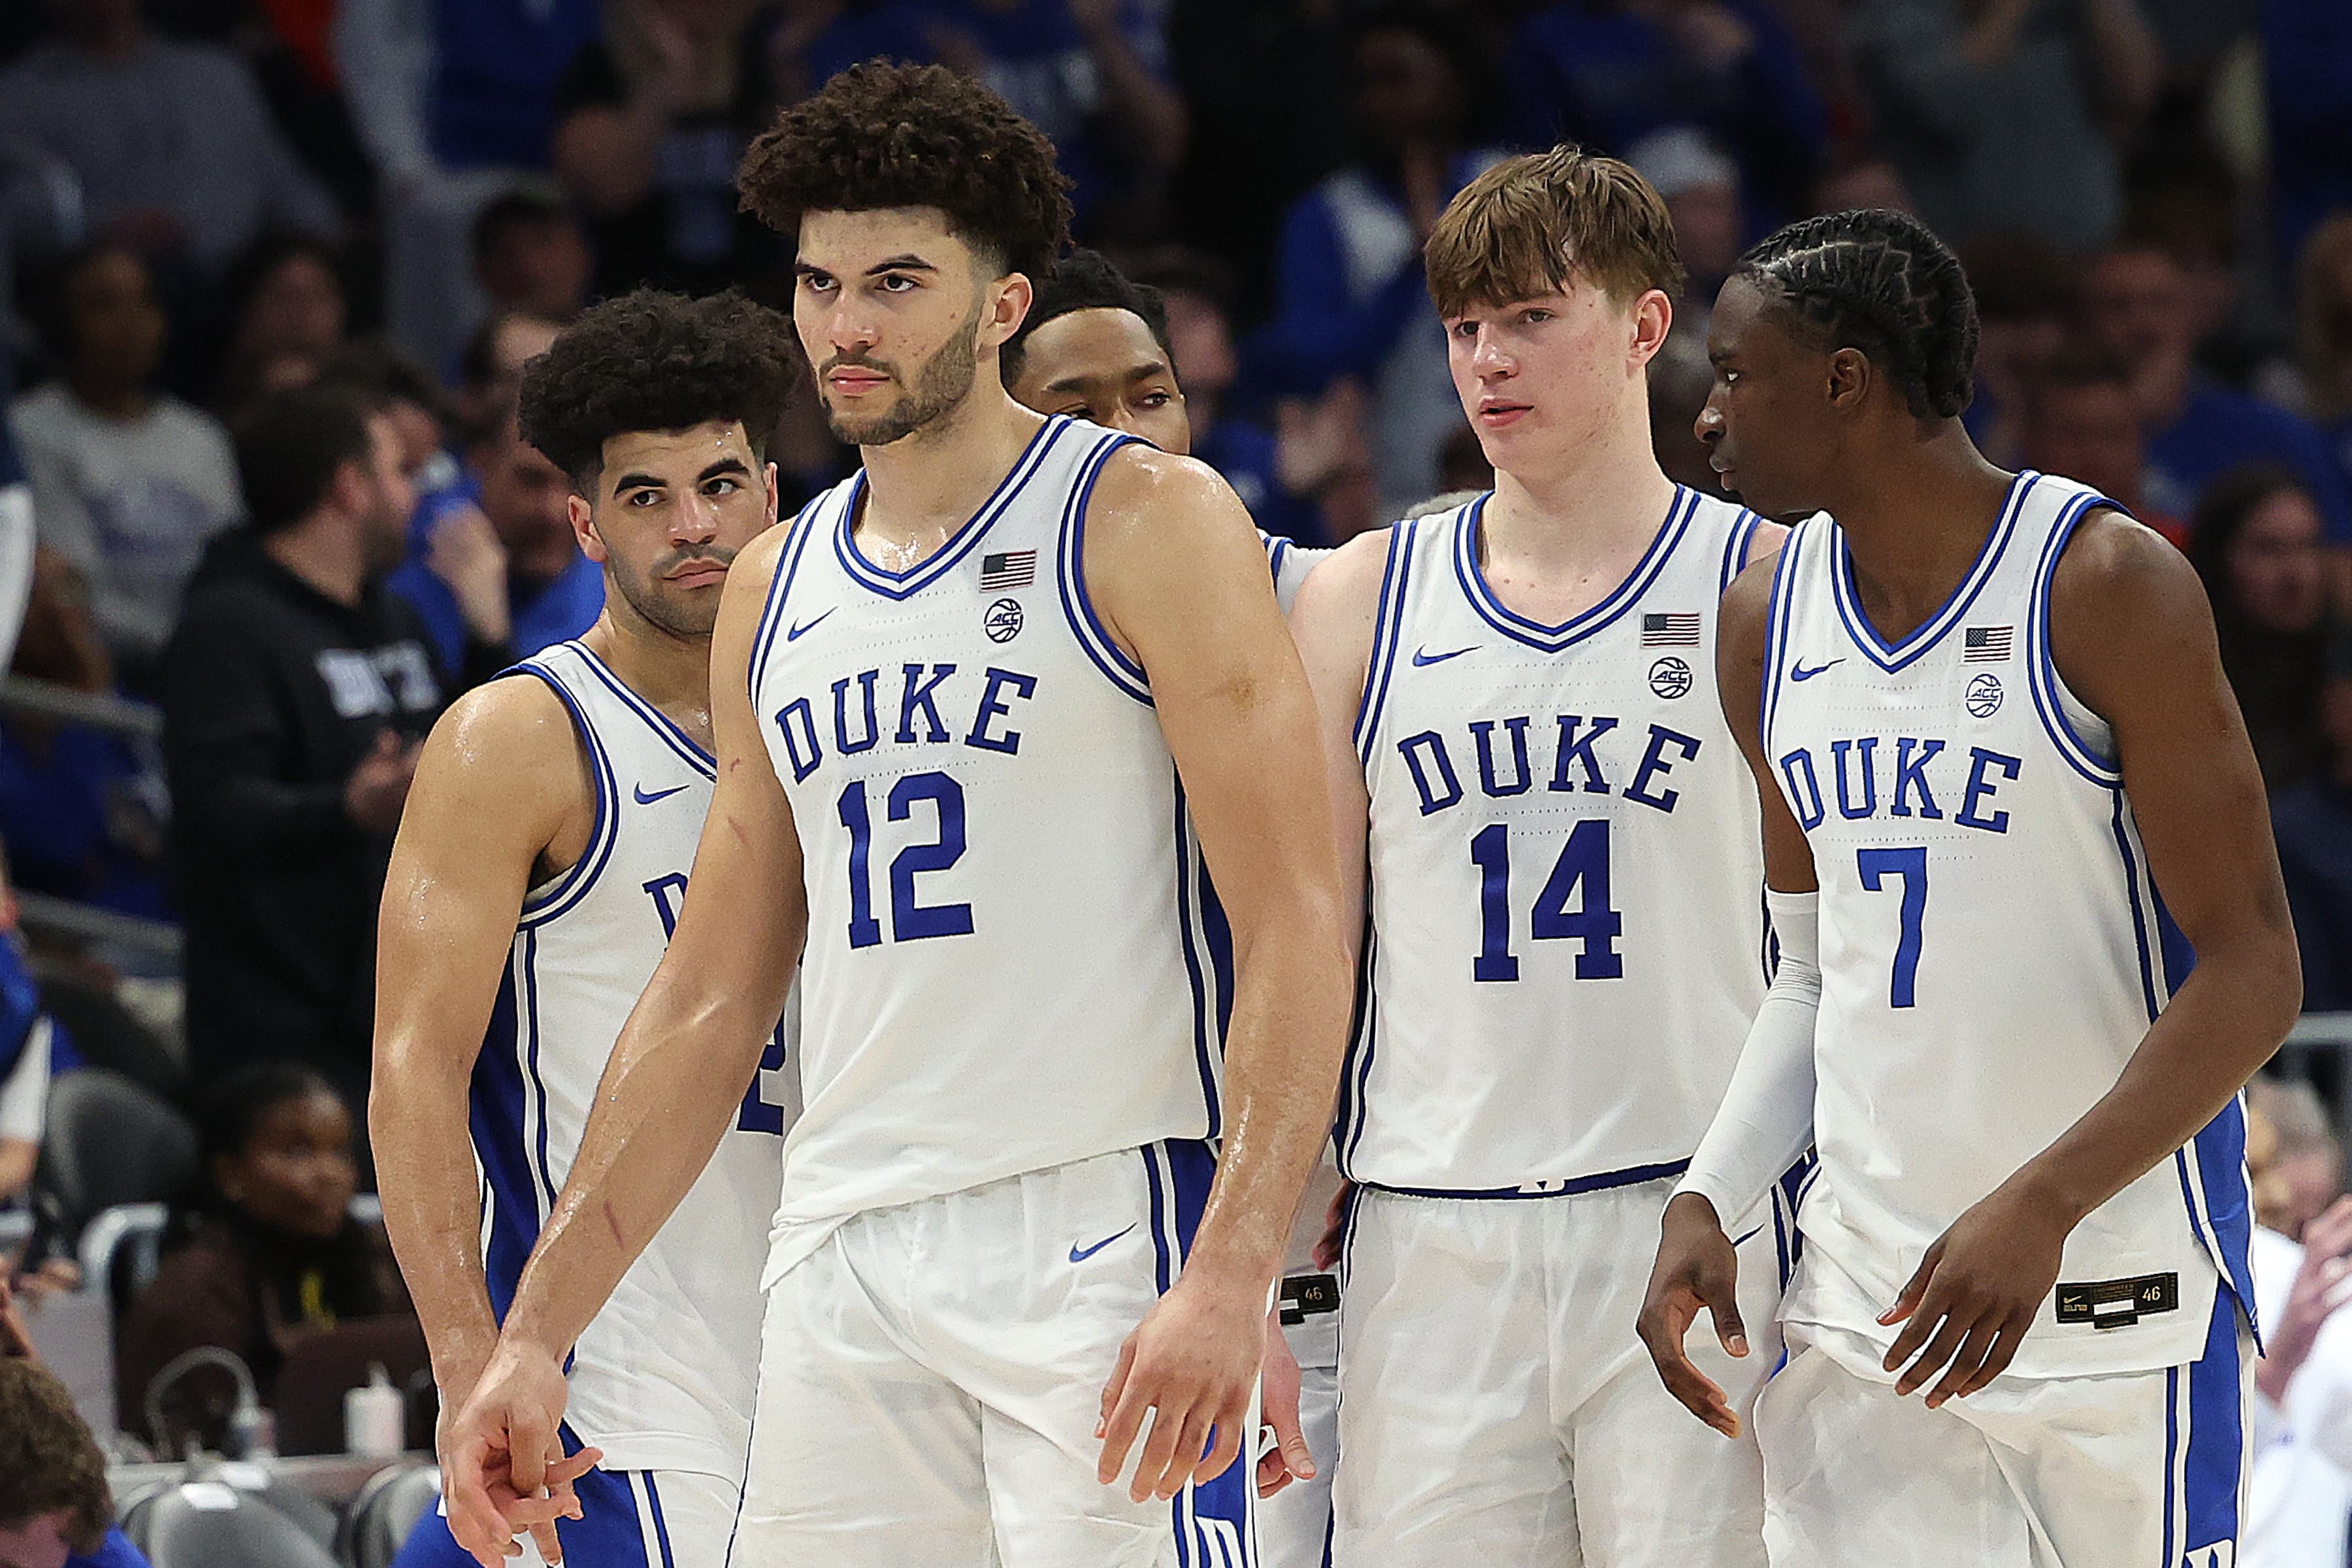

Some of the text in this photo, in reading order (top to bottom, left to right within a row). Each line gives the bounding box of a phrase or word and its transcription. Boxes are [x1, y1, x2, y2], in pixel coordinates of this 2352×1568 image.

[990, 612, 1021, 625] ACC
[776, 663, 1037, 784] DUKE
[1655, 670, 1690, 683] ACC
[1971, 688, 2001, 700] ACC
[1397, 715, 1702, 817] DUKE
[1780, 737, 2022, 834] DUKE
[837, 771, 975, 949] 12
[1471, 819, 1623, 982] 14
[1857, 846, 1928, 1008] 7
[1305, 1286, 1323, 1301] 46
[2142, 1286, 2161, 1302] 46
